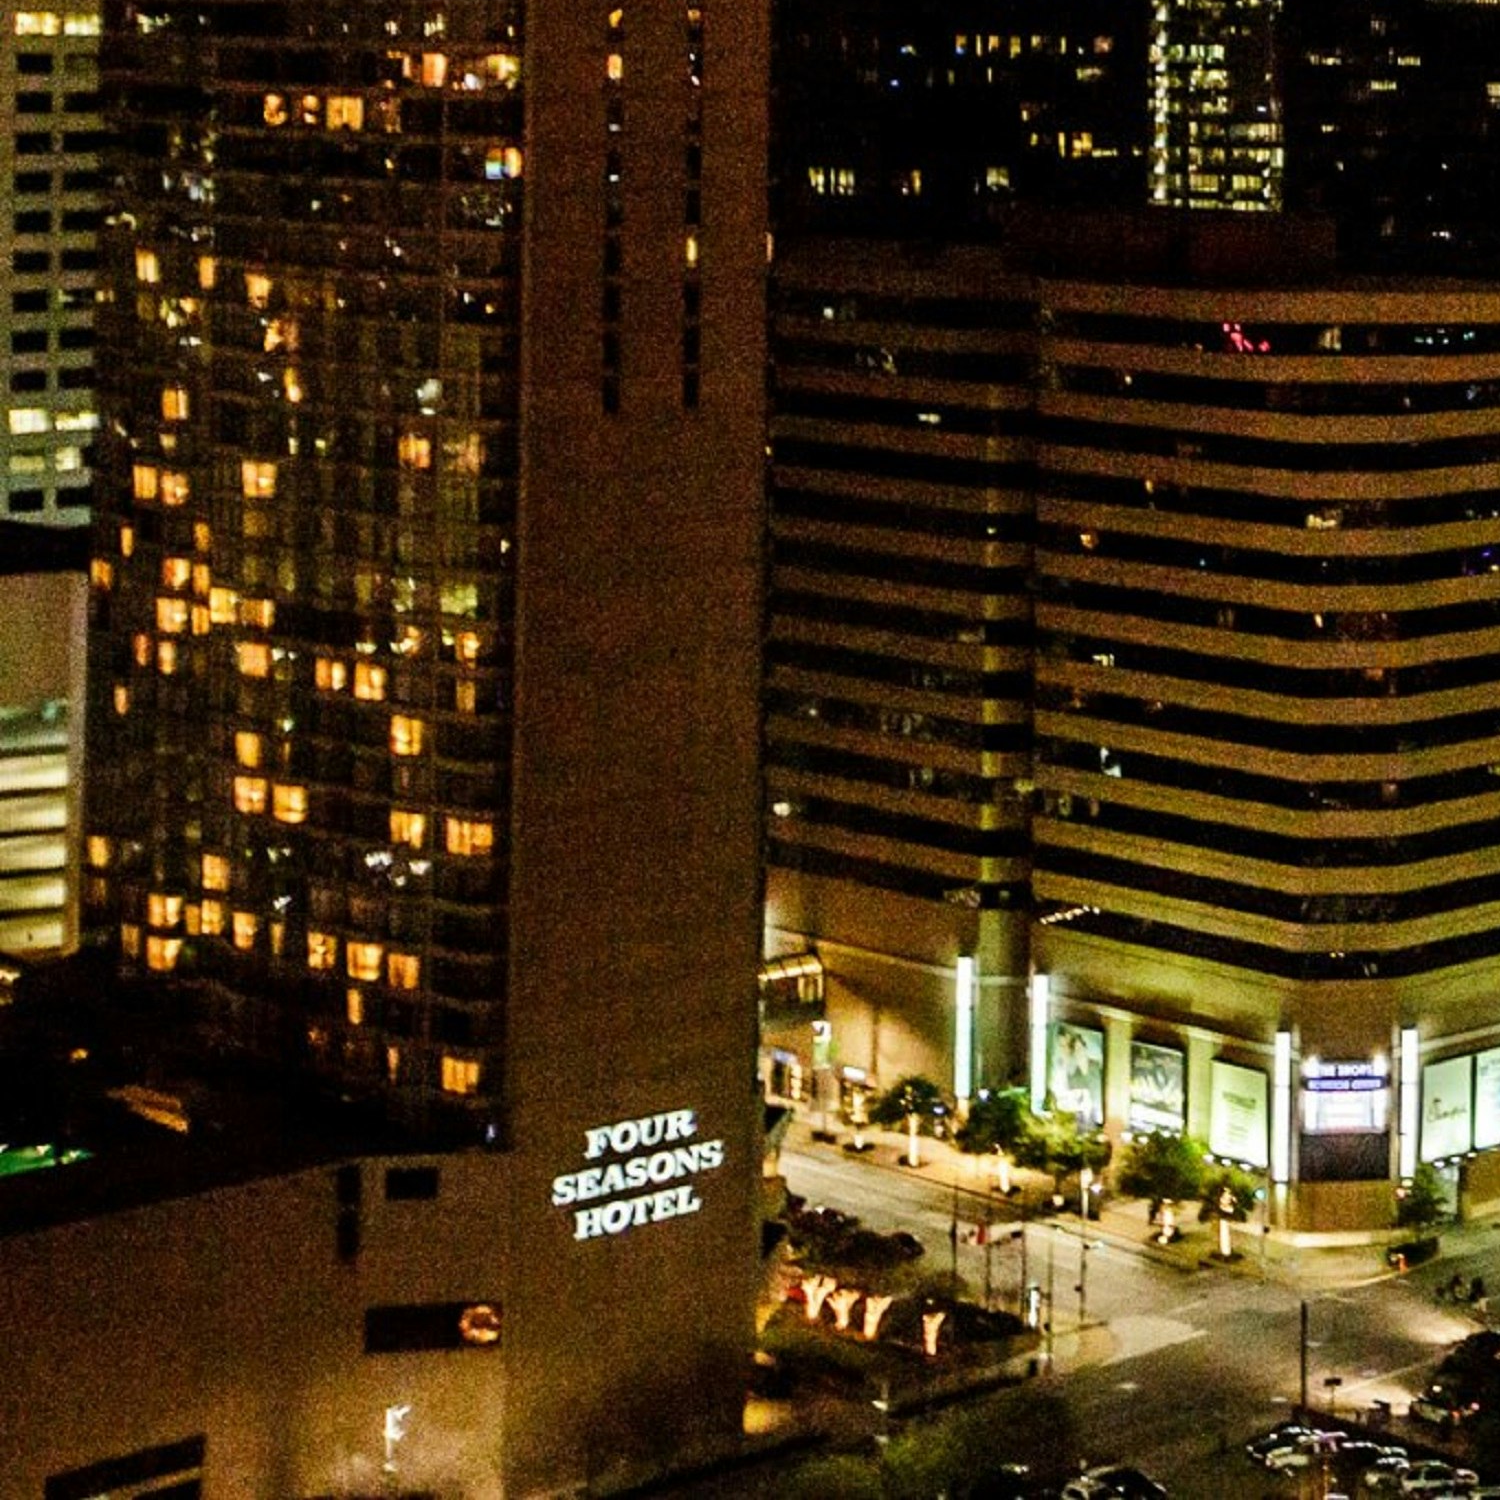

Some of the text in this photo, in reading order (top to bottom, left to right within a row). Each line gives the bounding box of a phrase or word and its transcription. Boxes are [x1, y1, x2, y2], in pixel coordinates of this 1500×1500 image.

[584, 1109, 697, 1160] FOUR
[552, 1140, 724, 1206] SEASONS
[573, 1186, 702, 1241] HOTEL
